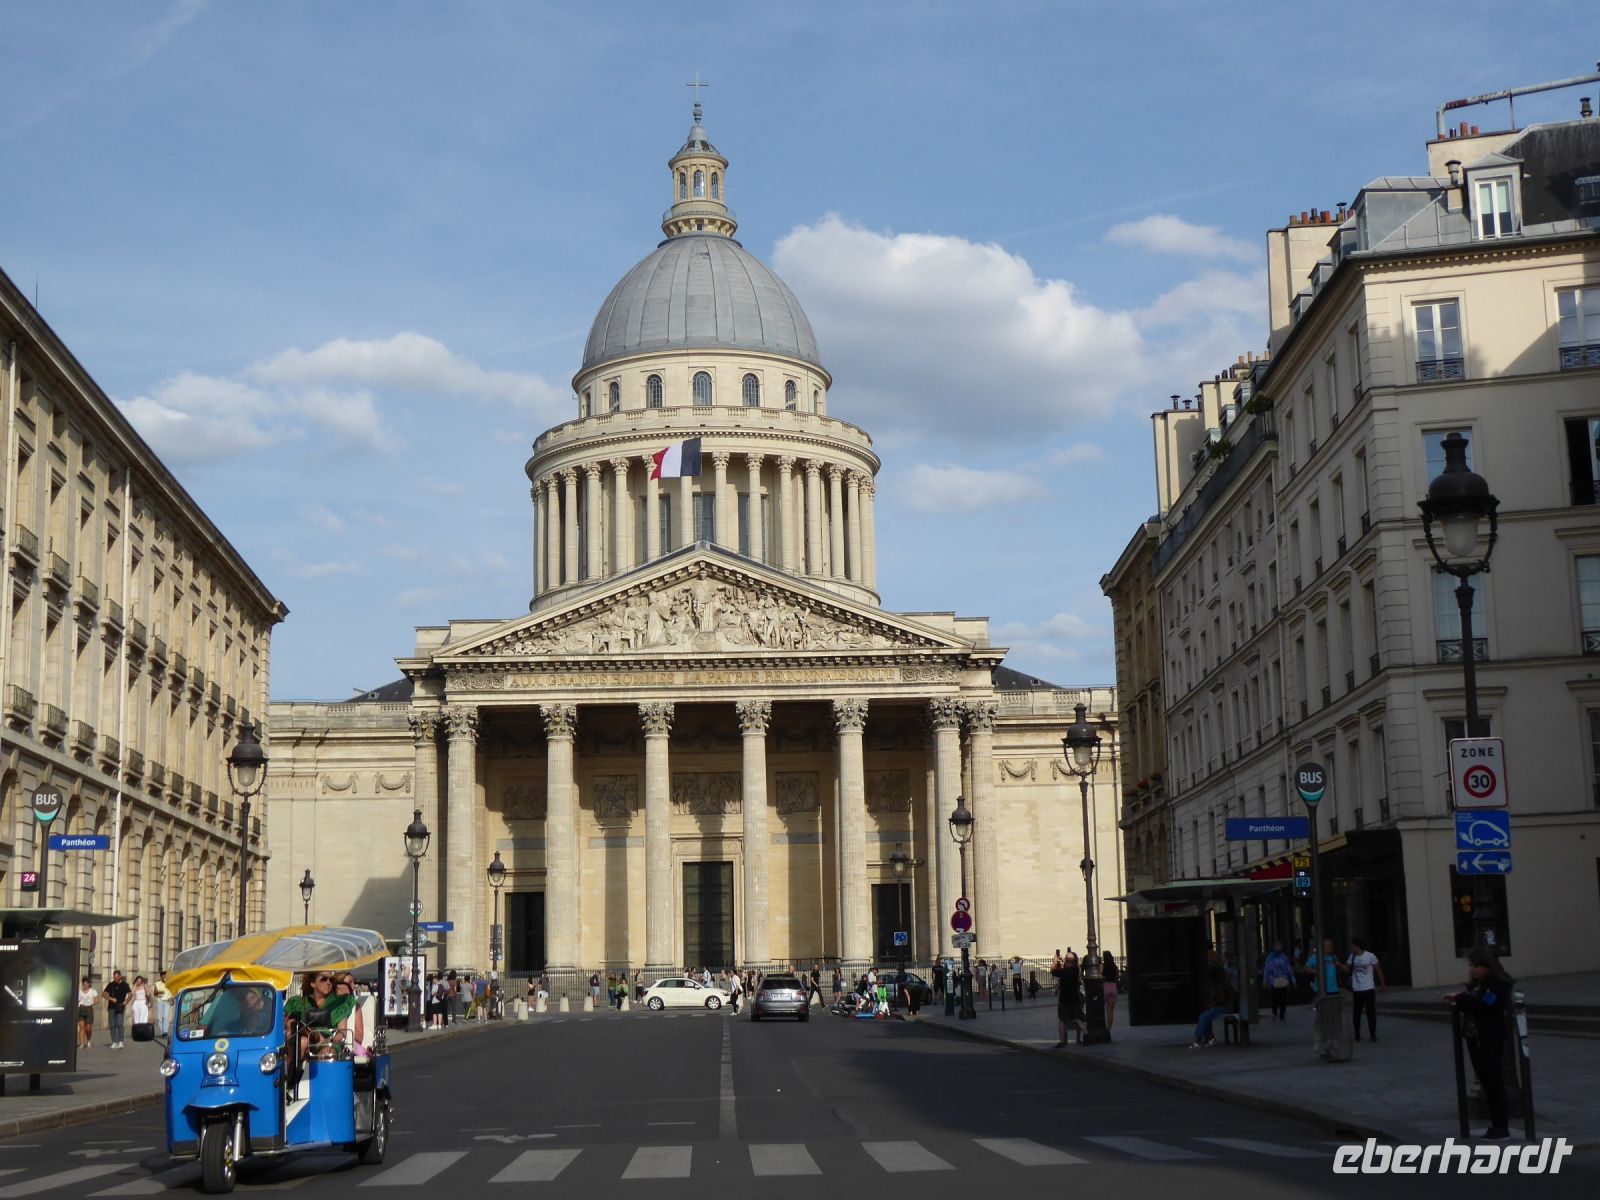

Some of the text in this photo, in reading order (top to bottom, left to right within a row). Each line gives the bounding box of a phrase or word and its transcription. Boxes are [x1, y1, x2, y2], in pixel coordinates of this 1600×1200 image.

[511, 668, 895, 687] AUX GRANDS HOMMES LA PATRIE RECONNAISSANTE
[1461, 747, 1495, 758] ZONE
[1299, 771, 1323, 784] BUS
[1470, 774, 1490, 789] 30
[35, 793, 58, 805] BUS
[1248, 824, 1285, 832] Panthéon
[61, 838, 96, 846] Panthéon
[1296, 857, 1309, 867] 75
[23, 873, 36, 883] 24
[1297, 877, 1309, 886] 89
